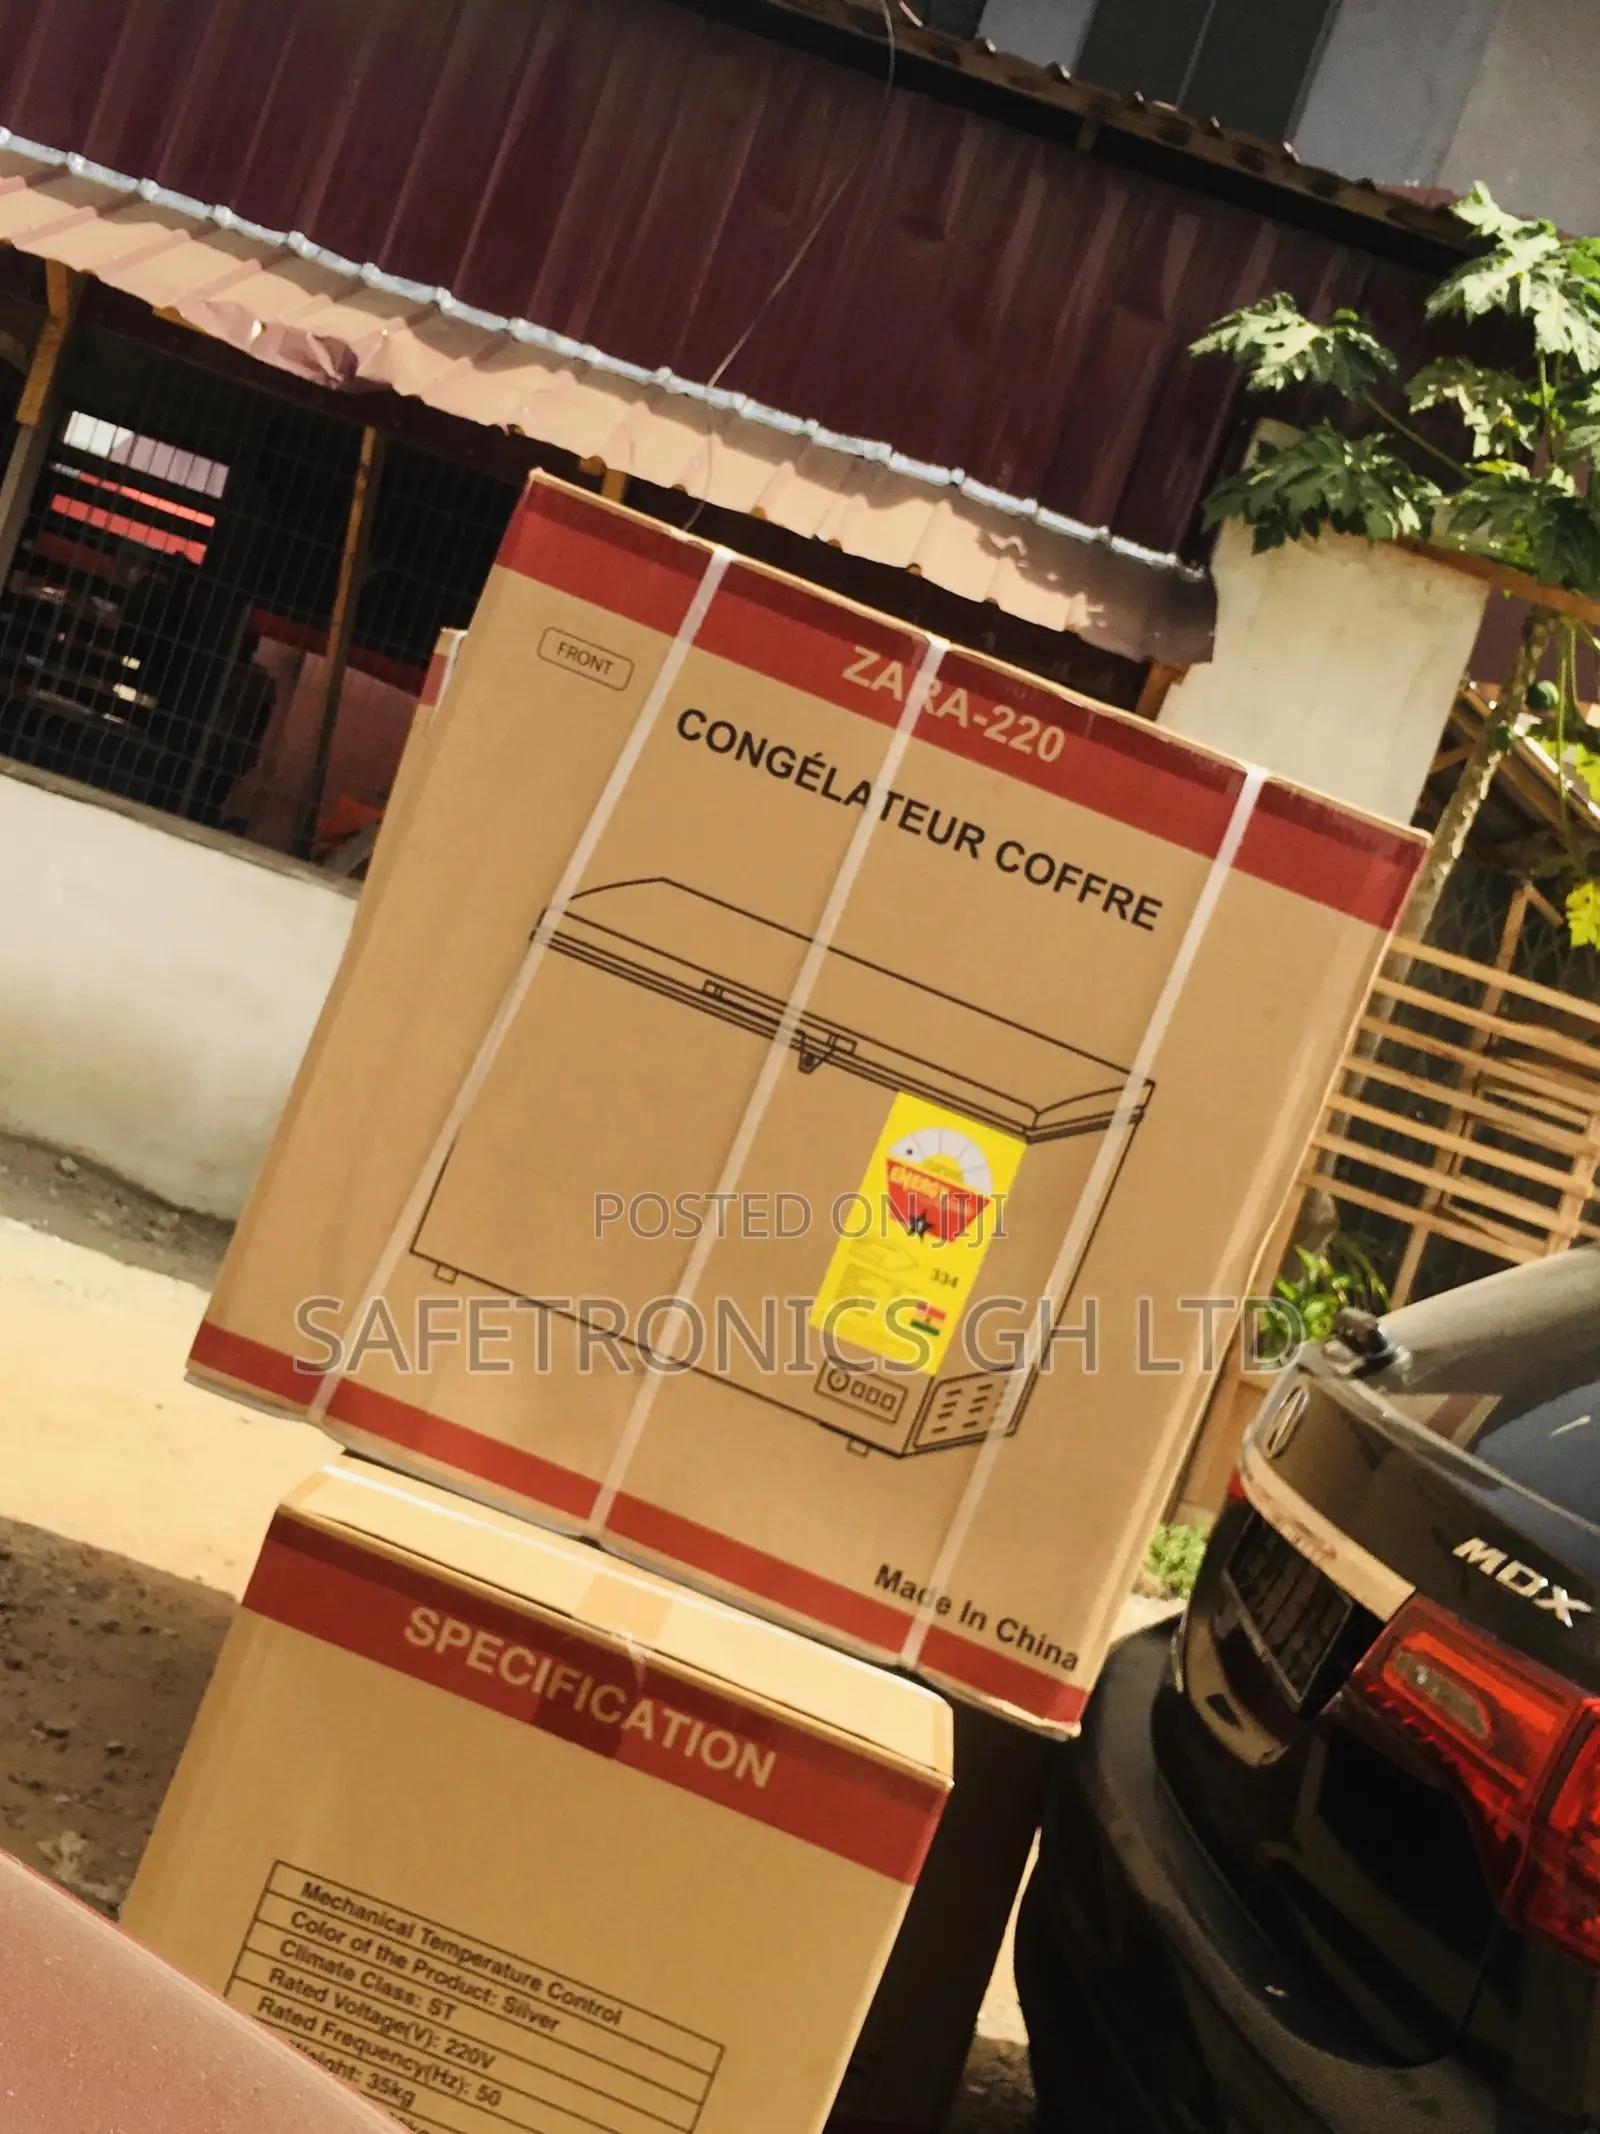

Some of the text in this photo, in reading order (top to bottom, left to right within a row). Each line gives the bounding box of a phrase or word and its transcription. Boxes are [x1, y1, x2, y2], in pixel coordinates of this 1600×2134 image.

[557, 640, 615, 675] FRONT
[842, 645, 1066, 763] ZARA-220
[677, 708, 1163, 931] CONGÉLATEUR COFFRE
[874, 1562, 1079, 1672] Made In China
[1452, 1537, 1592, 1628] MDX
[404, 1606, 777, 1788] SPECIFICATION
[280, 1939, 458, 2021] Climate Class: ST
[291, 1911, 561, 2032] Color of the Product: Silver
[301, 1881, 623, 2025] Mechanical Temperature Control
[257, 1996, 503, 2107] Rated Frequency(Hz): 50
[268, 1967, 497, 2070] Rated Voltage(V): 220V
[289, 2040, 363, 2082] eight:
